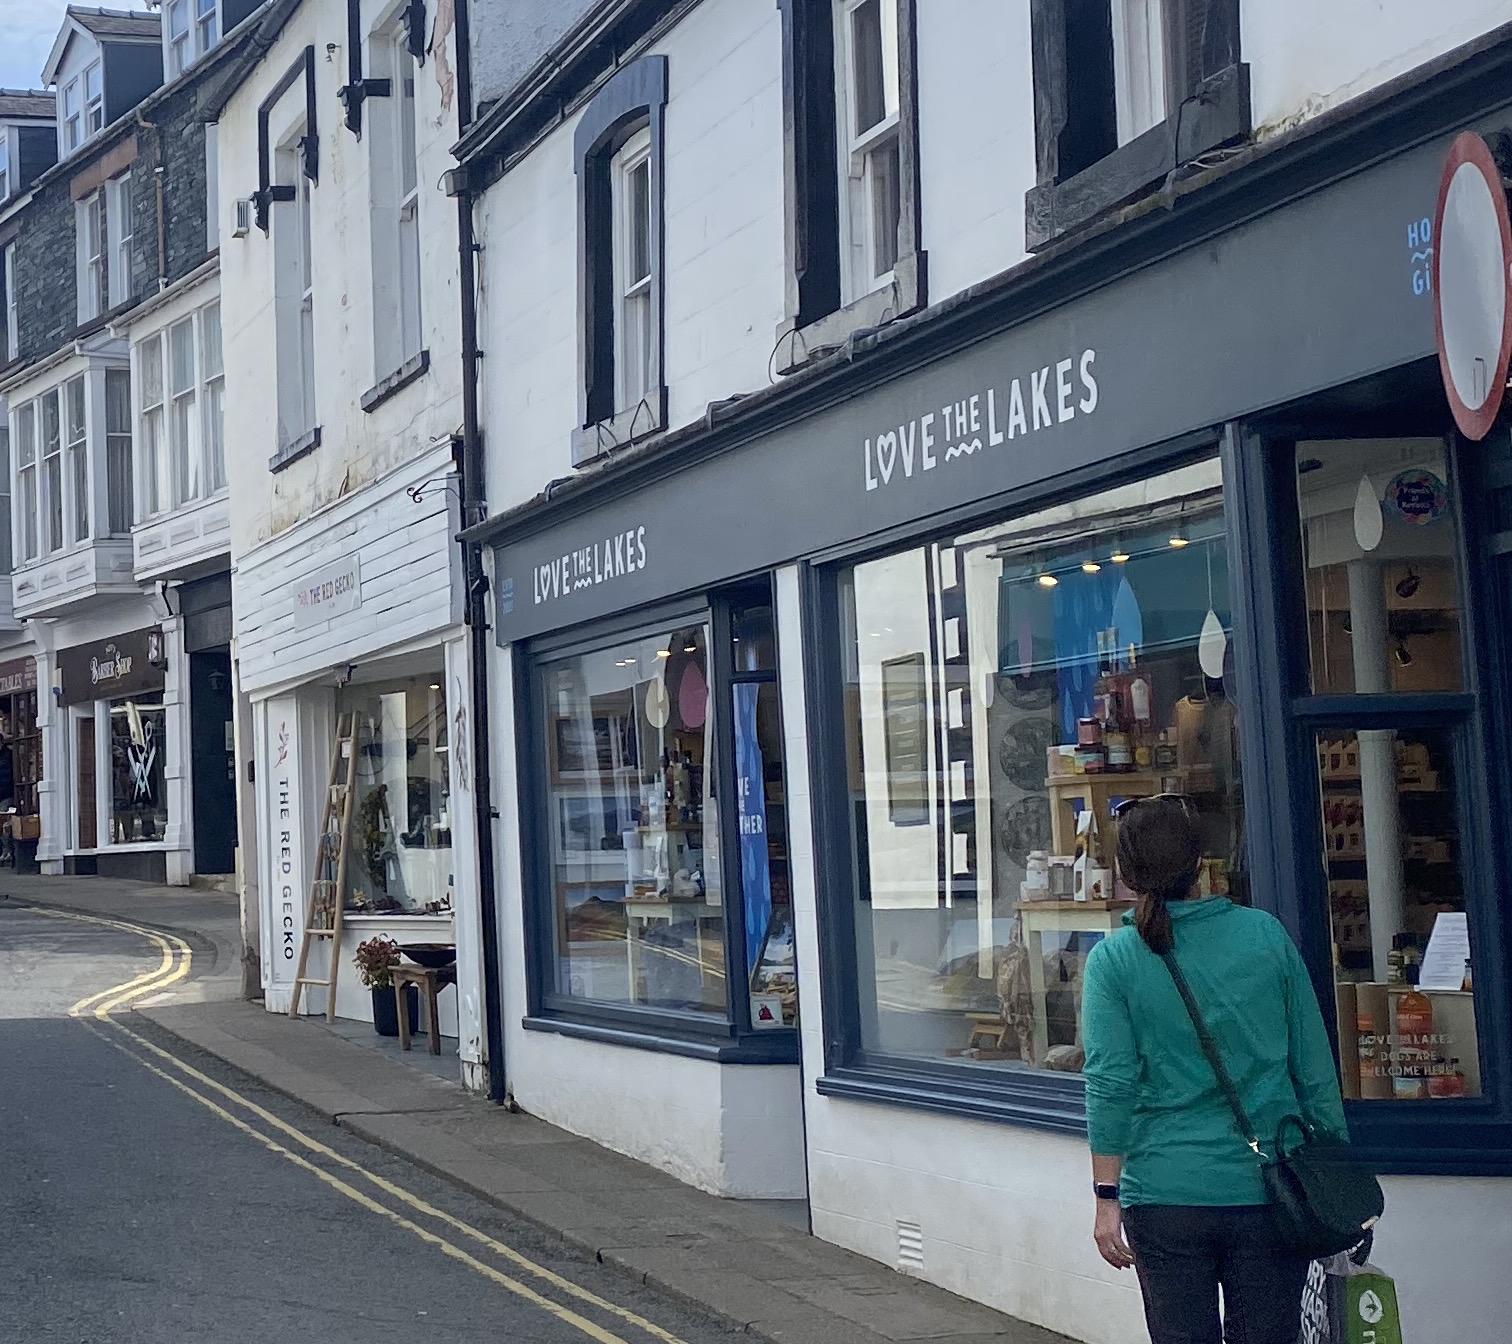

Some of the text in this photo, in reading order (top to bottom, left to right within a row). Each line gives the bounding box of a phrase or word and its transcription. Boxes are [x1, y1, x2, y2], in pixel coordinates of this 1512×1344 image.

[1407, 217, 1432, 248] HO
[864, 348, 1099, 492] LOVE THE LAKES
[533, 554, 571, 605] LOVE
[572, 546, 592, 577] THE
[594, 525, 646, 585] LAKES
[279, 776, 294, 960] THE RED GECKO
